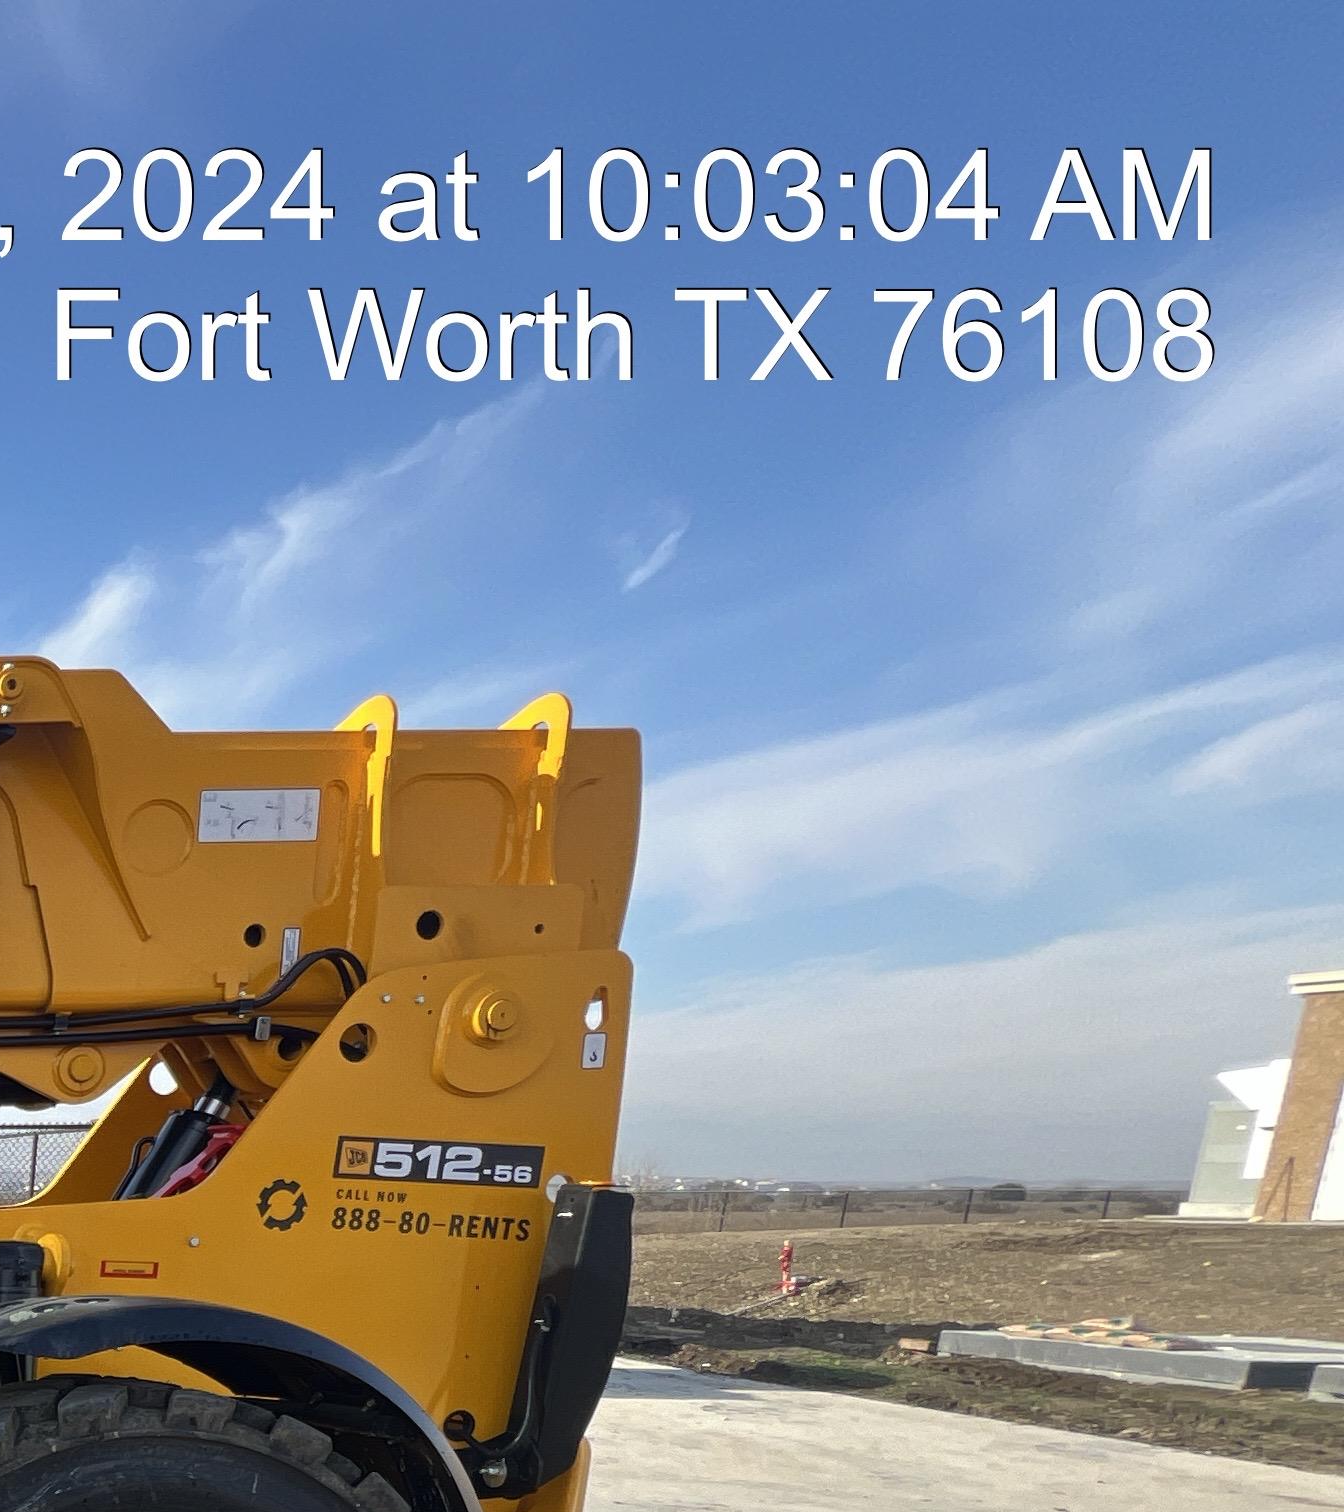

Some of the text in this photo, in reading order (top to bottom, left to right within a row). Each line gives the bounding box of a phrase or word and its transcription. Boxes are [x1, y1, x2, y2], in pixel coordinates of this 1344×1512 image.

[335, 1188, 408, 1203] CALL NOW
[331, 1206, 532, 1242] 888-80-RENTS
